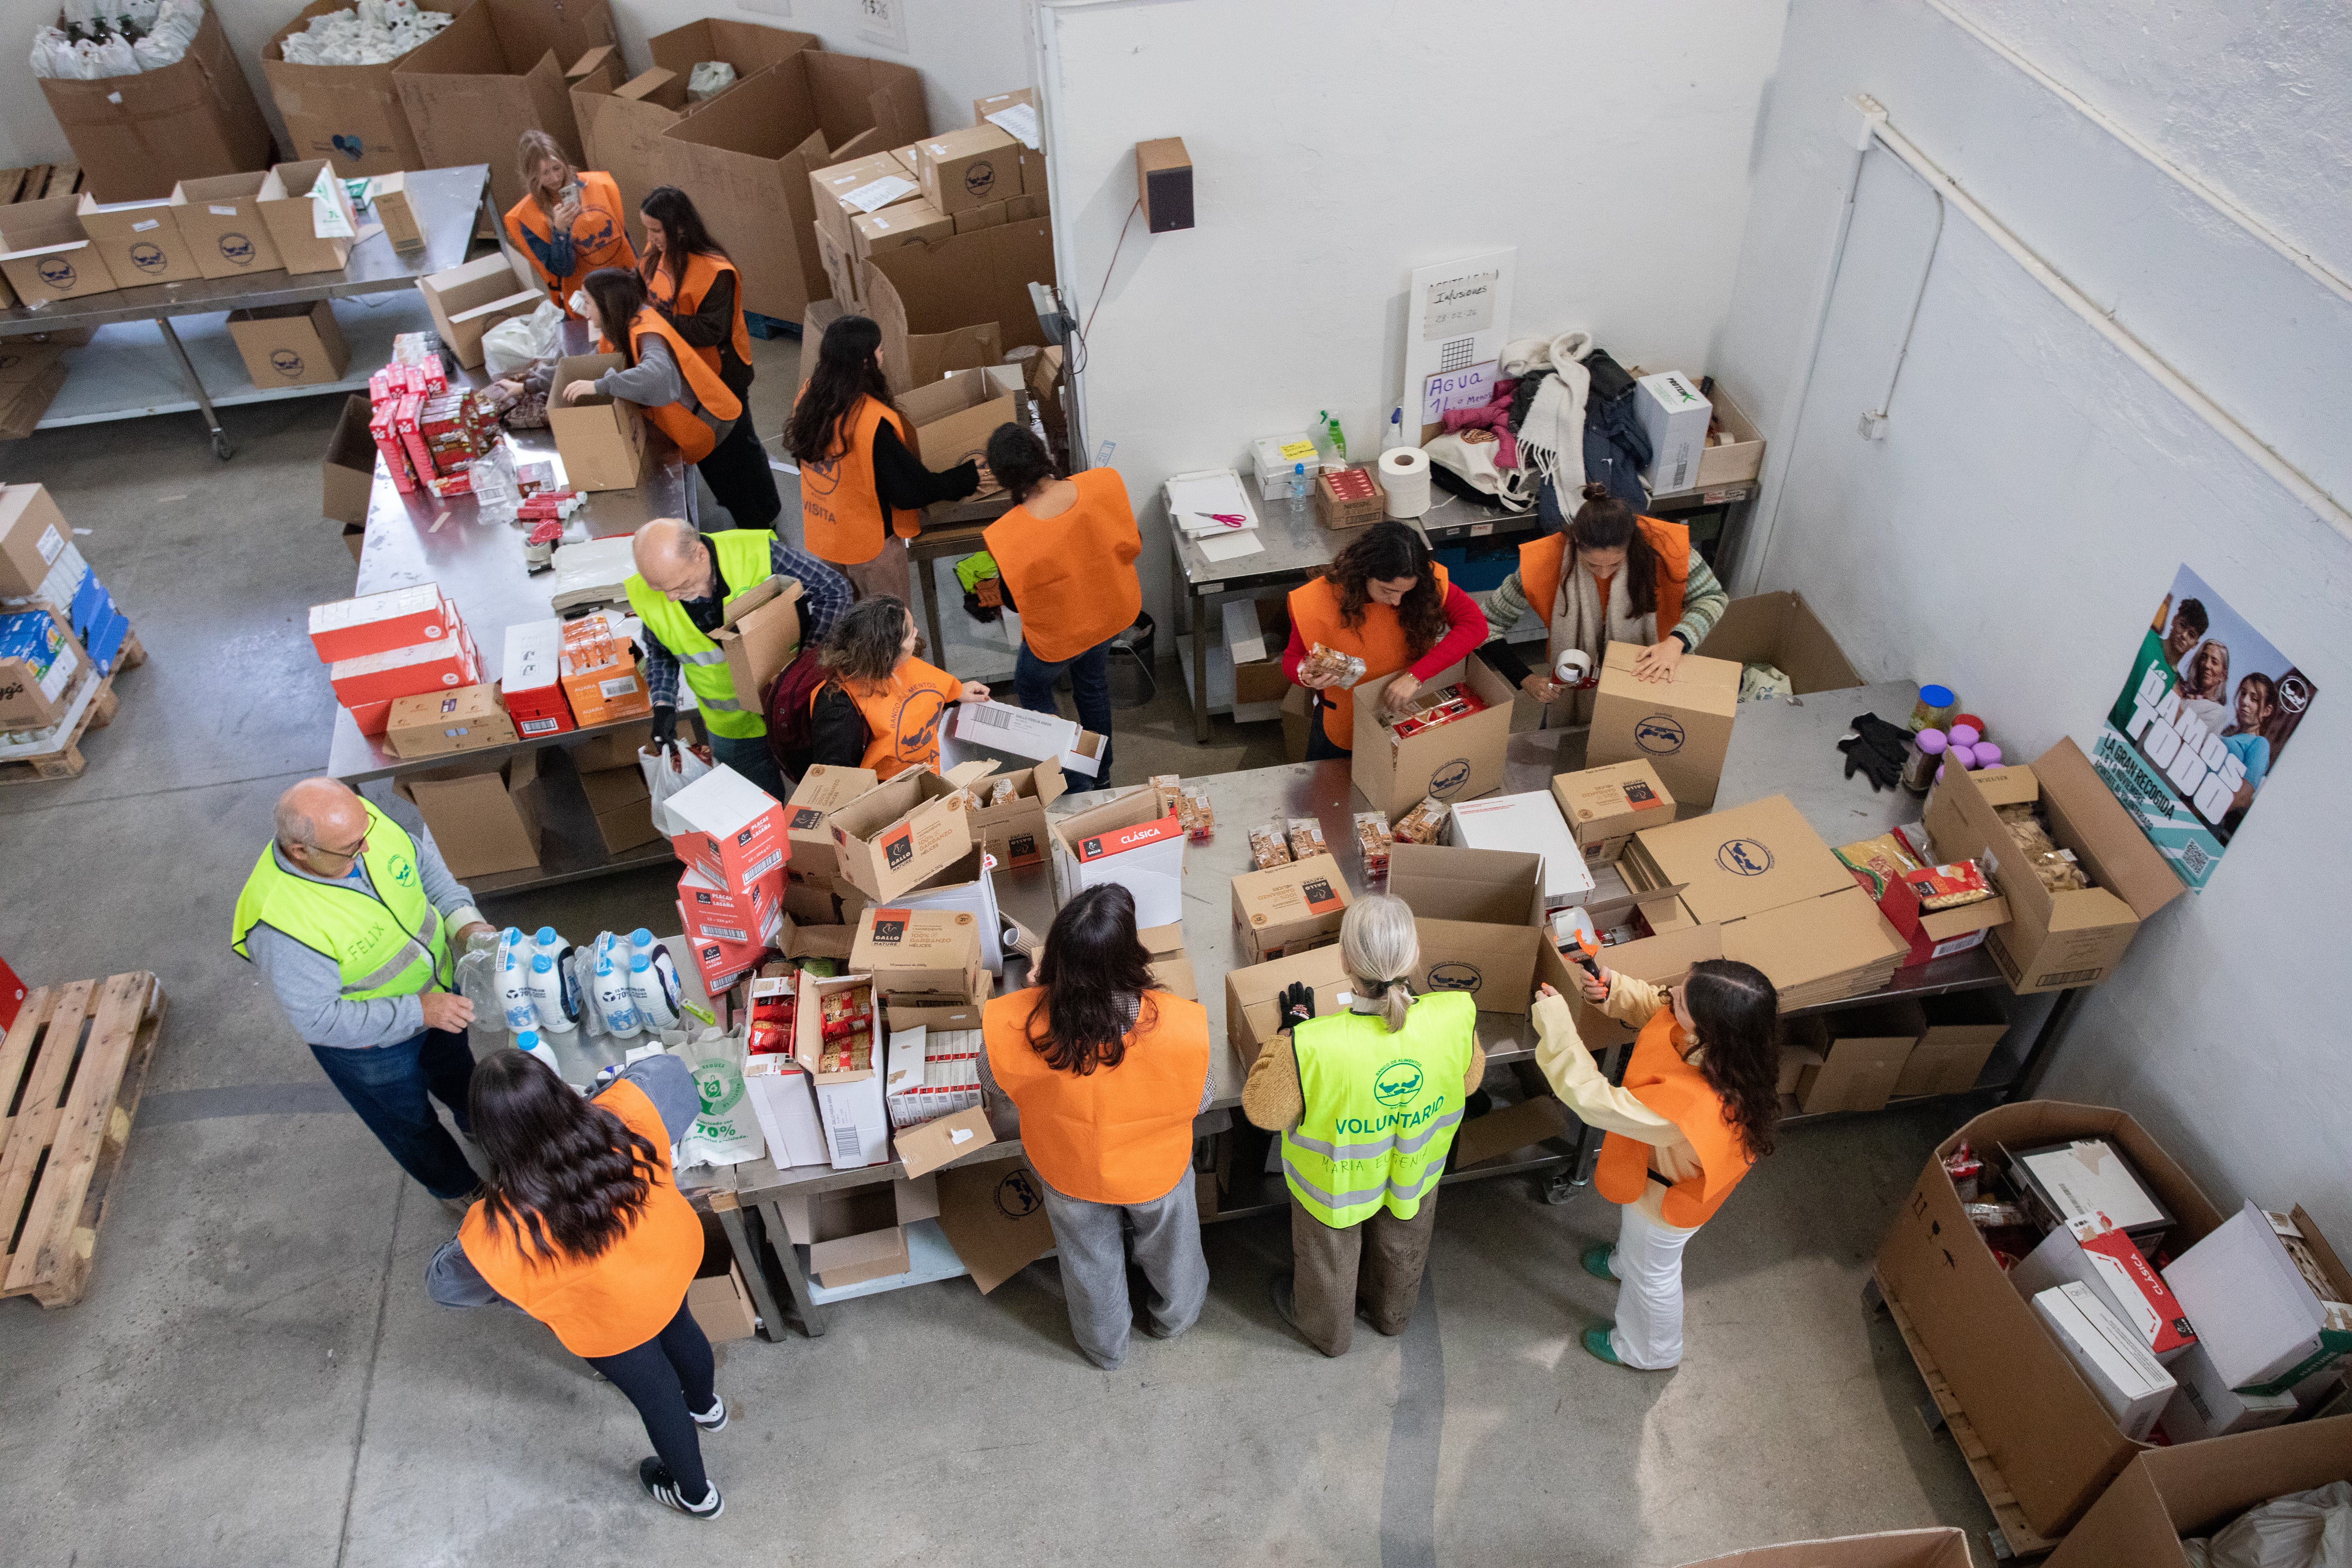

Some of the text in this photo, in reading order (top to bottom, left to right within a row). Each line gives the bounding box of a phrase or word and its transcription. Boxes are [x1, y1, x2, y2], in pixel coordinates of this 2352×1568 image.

[1432, 286, 1487, 305] Infusiones
[890, 702, 901, 729] BANCO
[2138, 667, 2248, 793] DAMOS
[2125, 691, 2234, 825] TODO
[2104, 732, 2175, 820] LA GRAN RECOGIDA
[751, 815, 769, 831] PLACAS
[807, 812, 819, 828] GALLO
[919, 828, 953, 851] GARBANZO
[1120, 828, 1161, 844] CLÁSICA
[891, 852, 911, 866] GALLO
[892, 859, 912, 872] NATURE
[1305, 882, 1327, 890] GALLO
[348, 922, 384, 961] FELIX
[1375, 1063, 1390, 1076] BANCO
[1398, 1059, 1422, 1068] ALIMENTOS
[1335, 1095, 1445, 1135] VOLUNTARIO
[696, 1123, 736, 1138] 70%
[1321, 1155, 1364, 1174] MARIA
[2130, 1253, 2163, 1296] CLÁSICA
